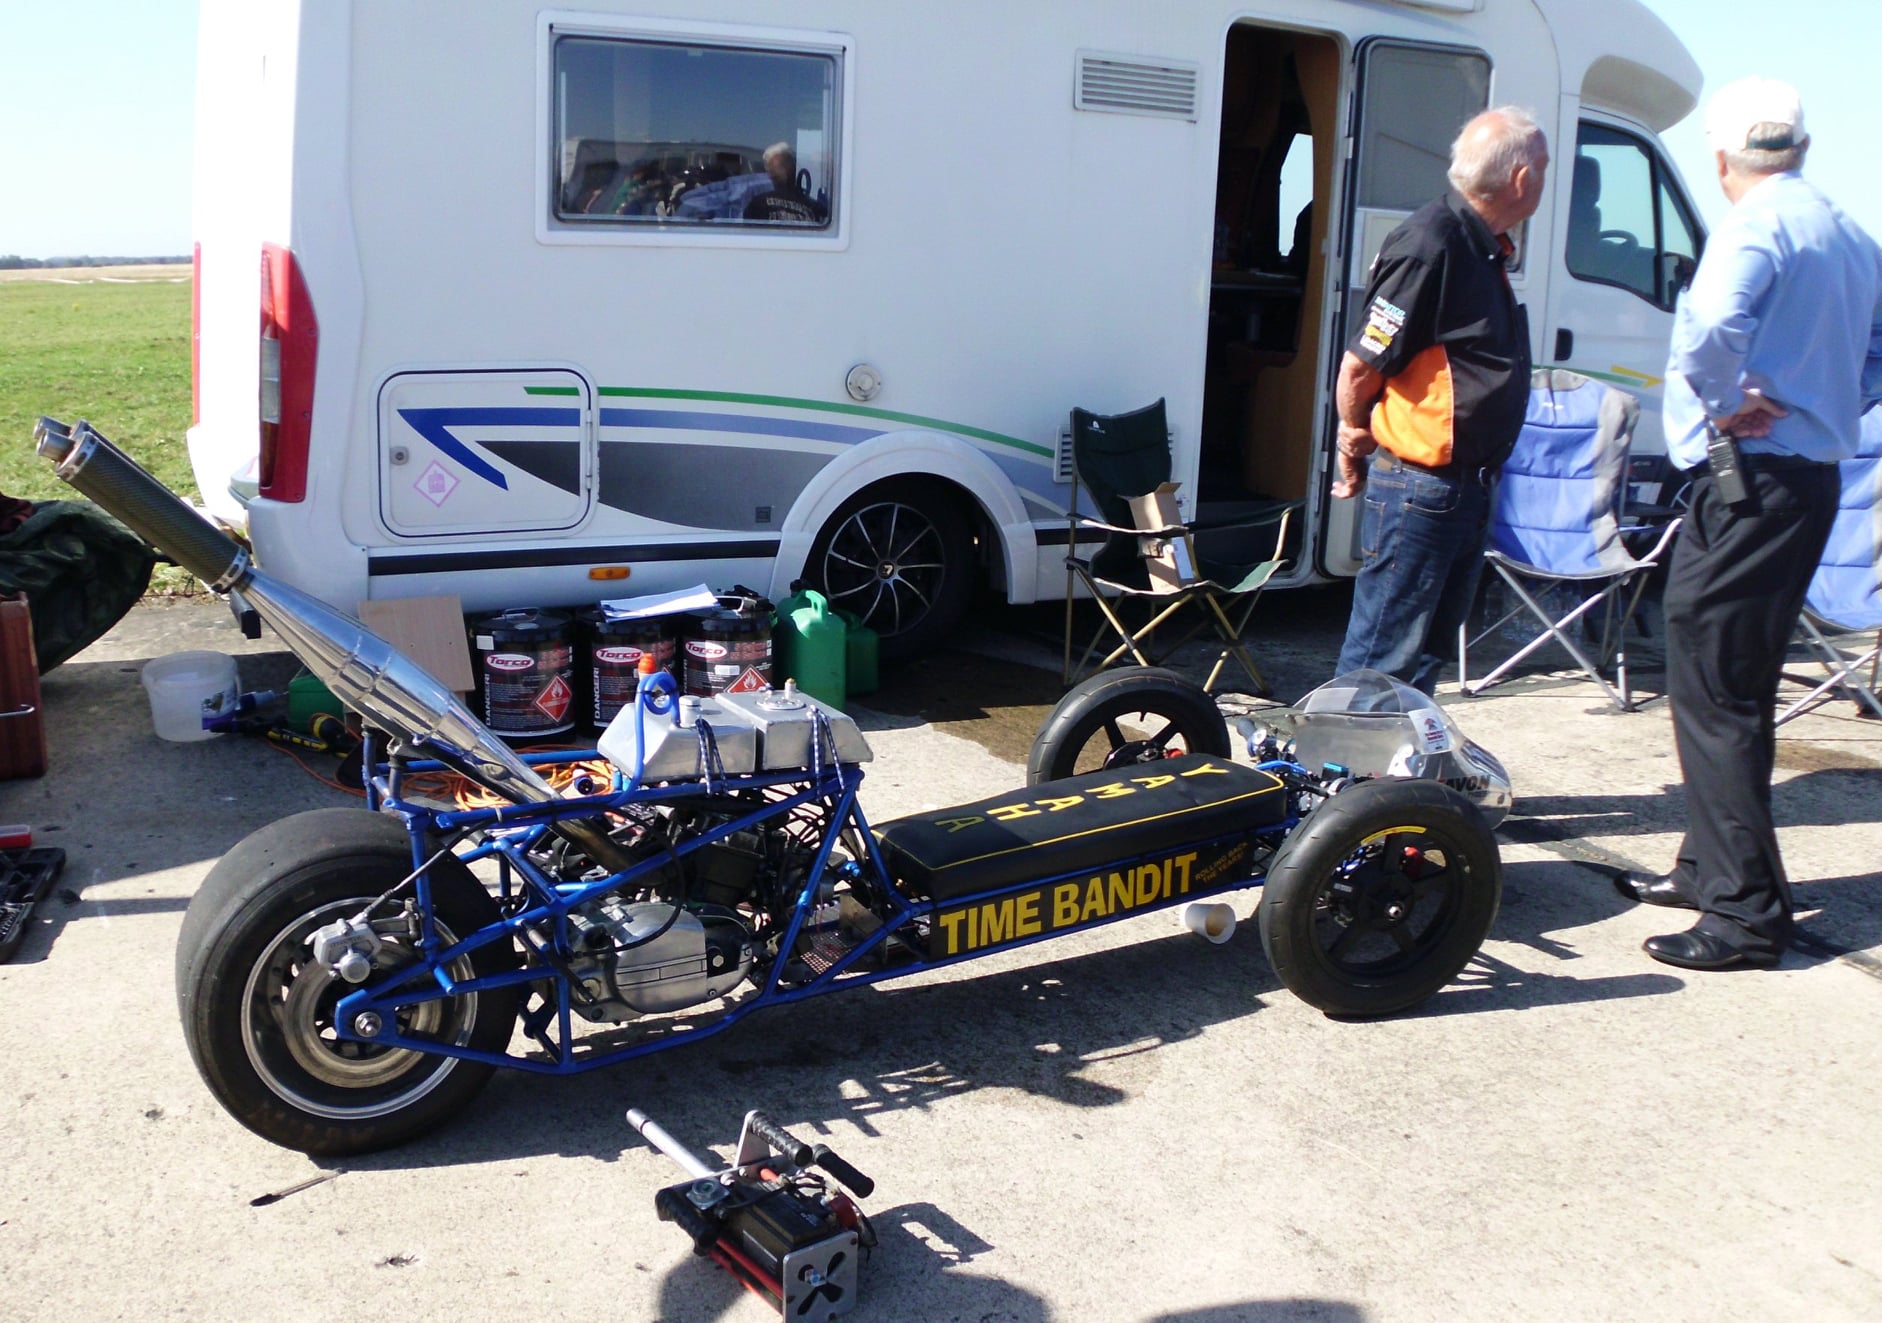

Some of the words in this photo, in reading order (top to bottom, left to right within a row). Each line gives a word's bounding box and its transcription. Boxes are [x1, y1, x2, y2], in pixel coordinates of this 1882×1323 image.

[599, 649, 641, 659] Torco
[687, 642, 724, 655] Torco
[490, 656, 531, 666] Torco
[593, 667, 601, 719] DANGER!
[939, 891, 1042, 955] TIME
[1052, 851, 1198, 928] BANDIT
